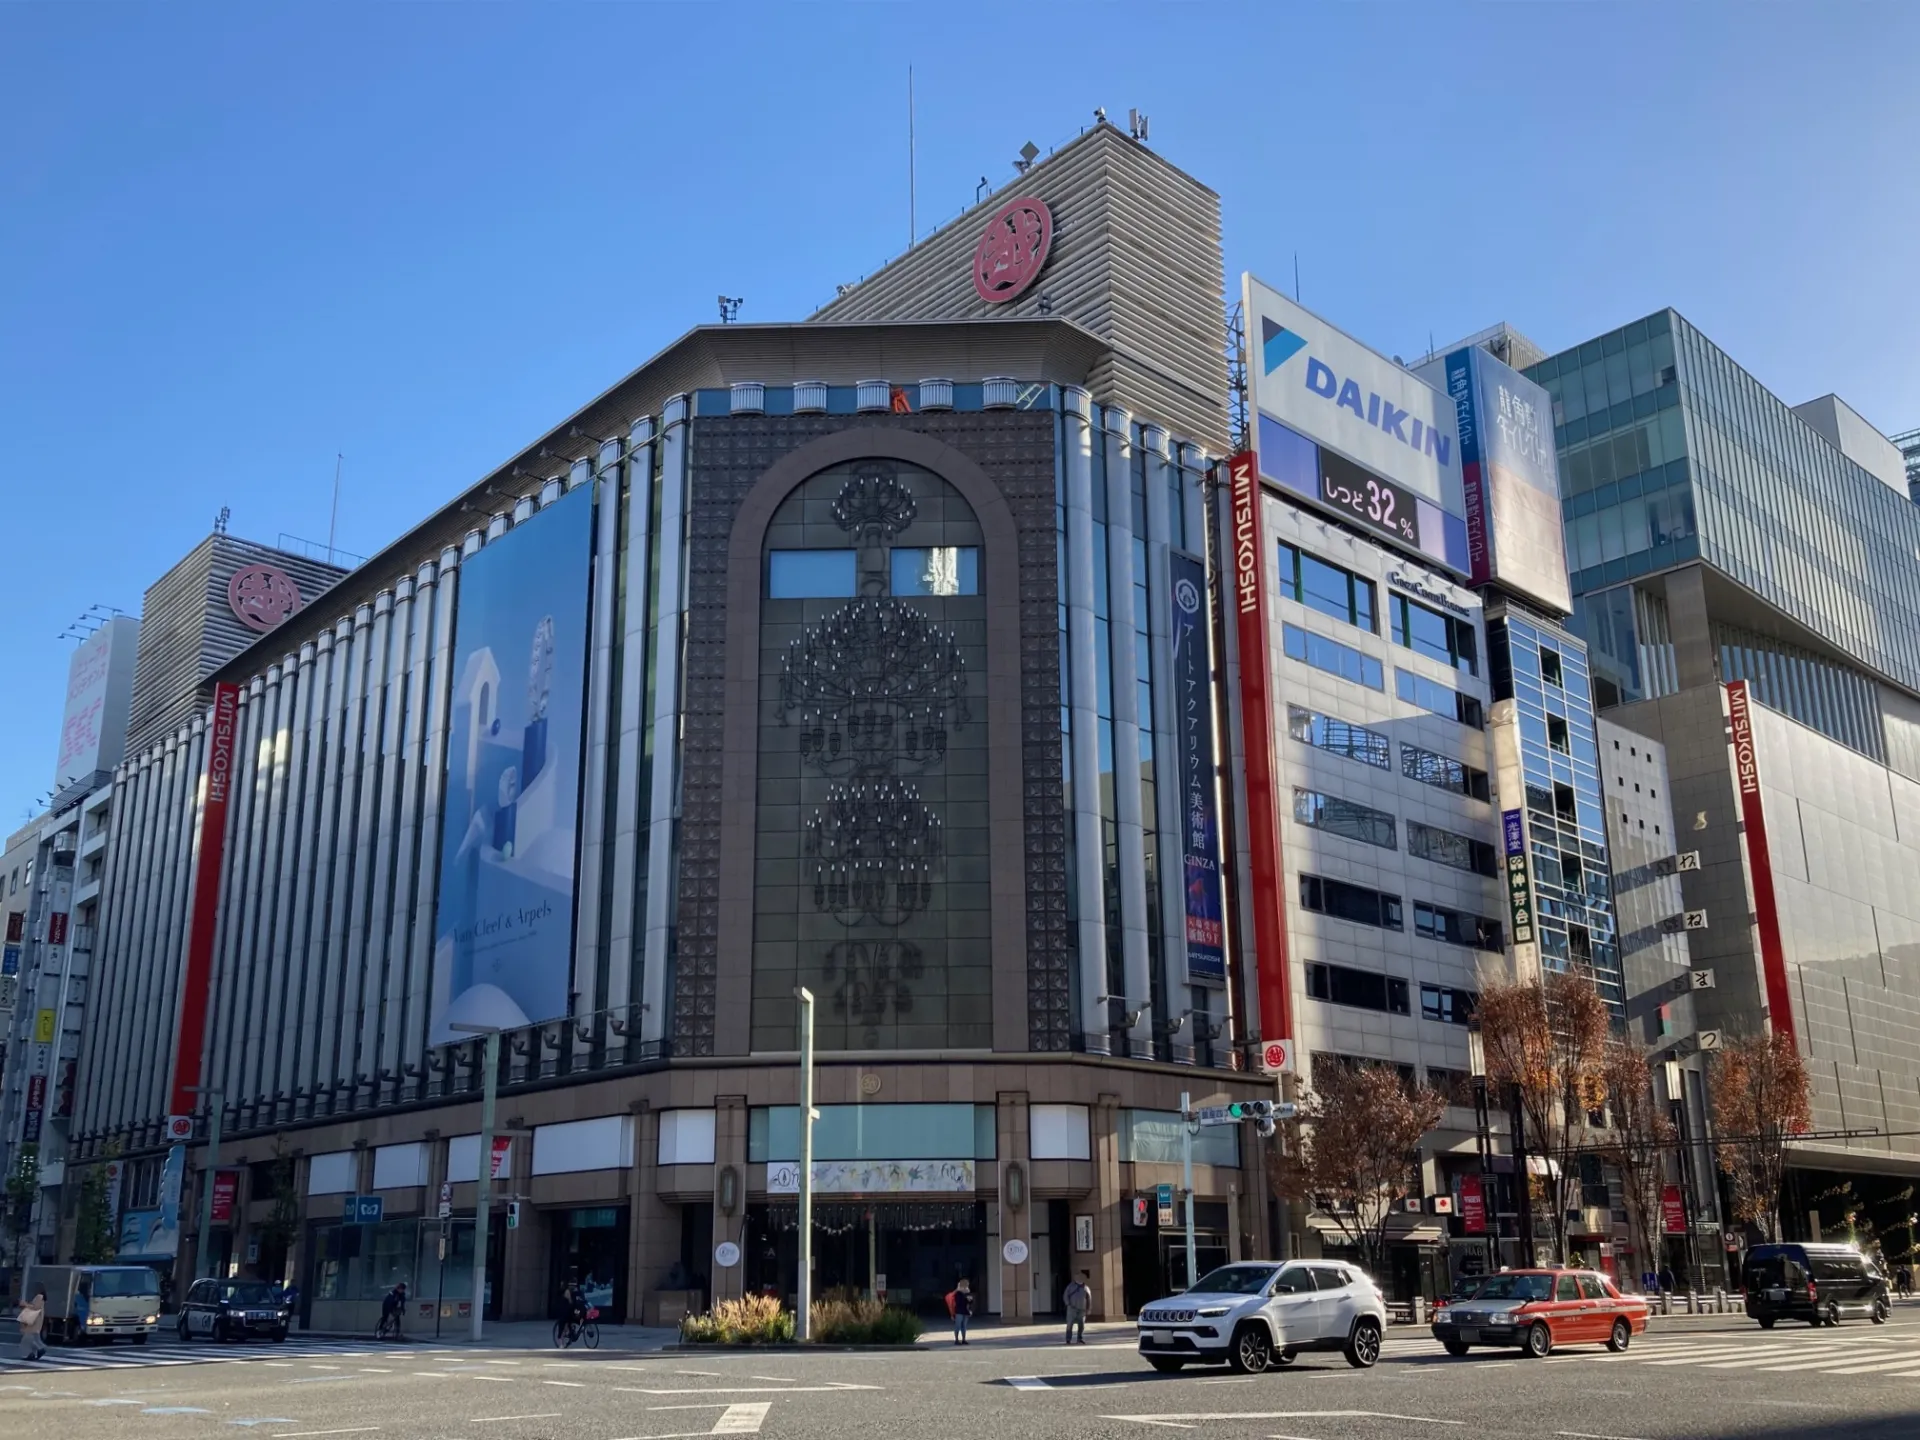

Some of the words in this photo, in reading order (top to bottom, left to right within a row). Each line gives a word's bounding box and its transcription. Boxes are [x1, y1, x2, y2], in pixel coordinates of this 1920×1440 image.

[1305, 356, 1450, 468] DAIKIN
[1233, 463, 1256, 614] MITSUKOSHI
[1326, 477, 1363, 512] しつど
[210, 691, 235, 802] MITSUKOSHI
[1184, 623, 1205, 850] アートアクアリウム美術館
[1731, 689, 1756, 793] MITSUKOSHI
[1184, 853, 1216, 871] GINZA
[474, 912, 504, 938] Cleef
[518, 899, 552, 928] Arpels
[1701, 1032, 1716, 1047] つ
